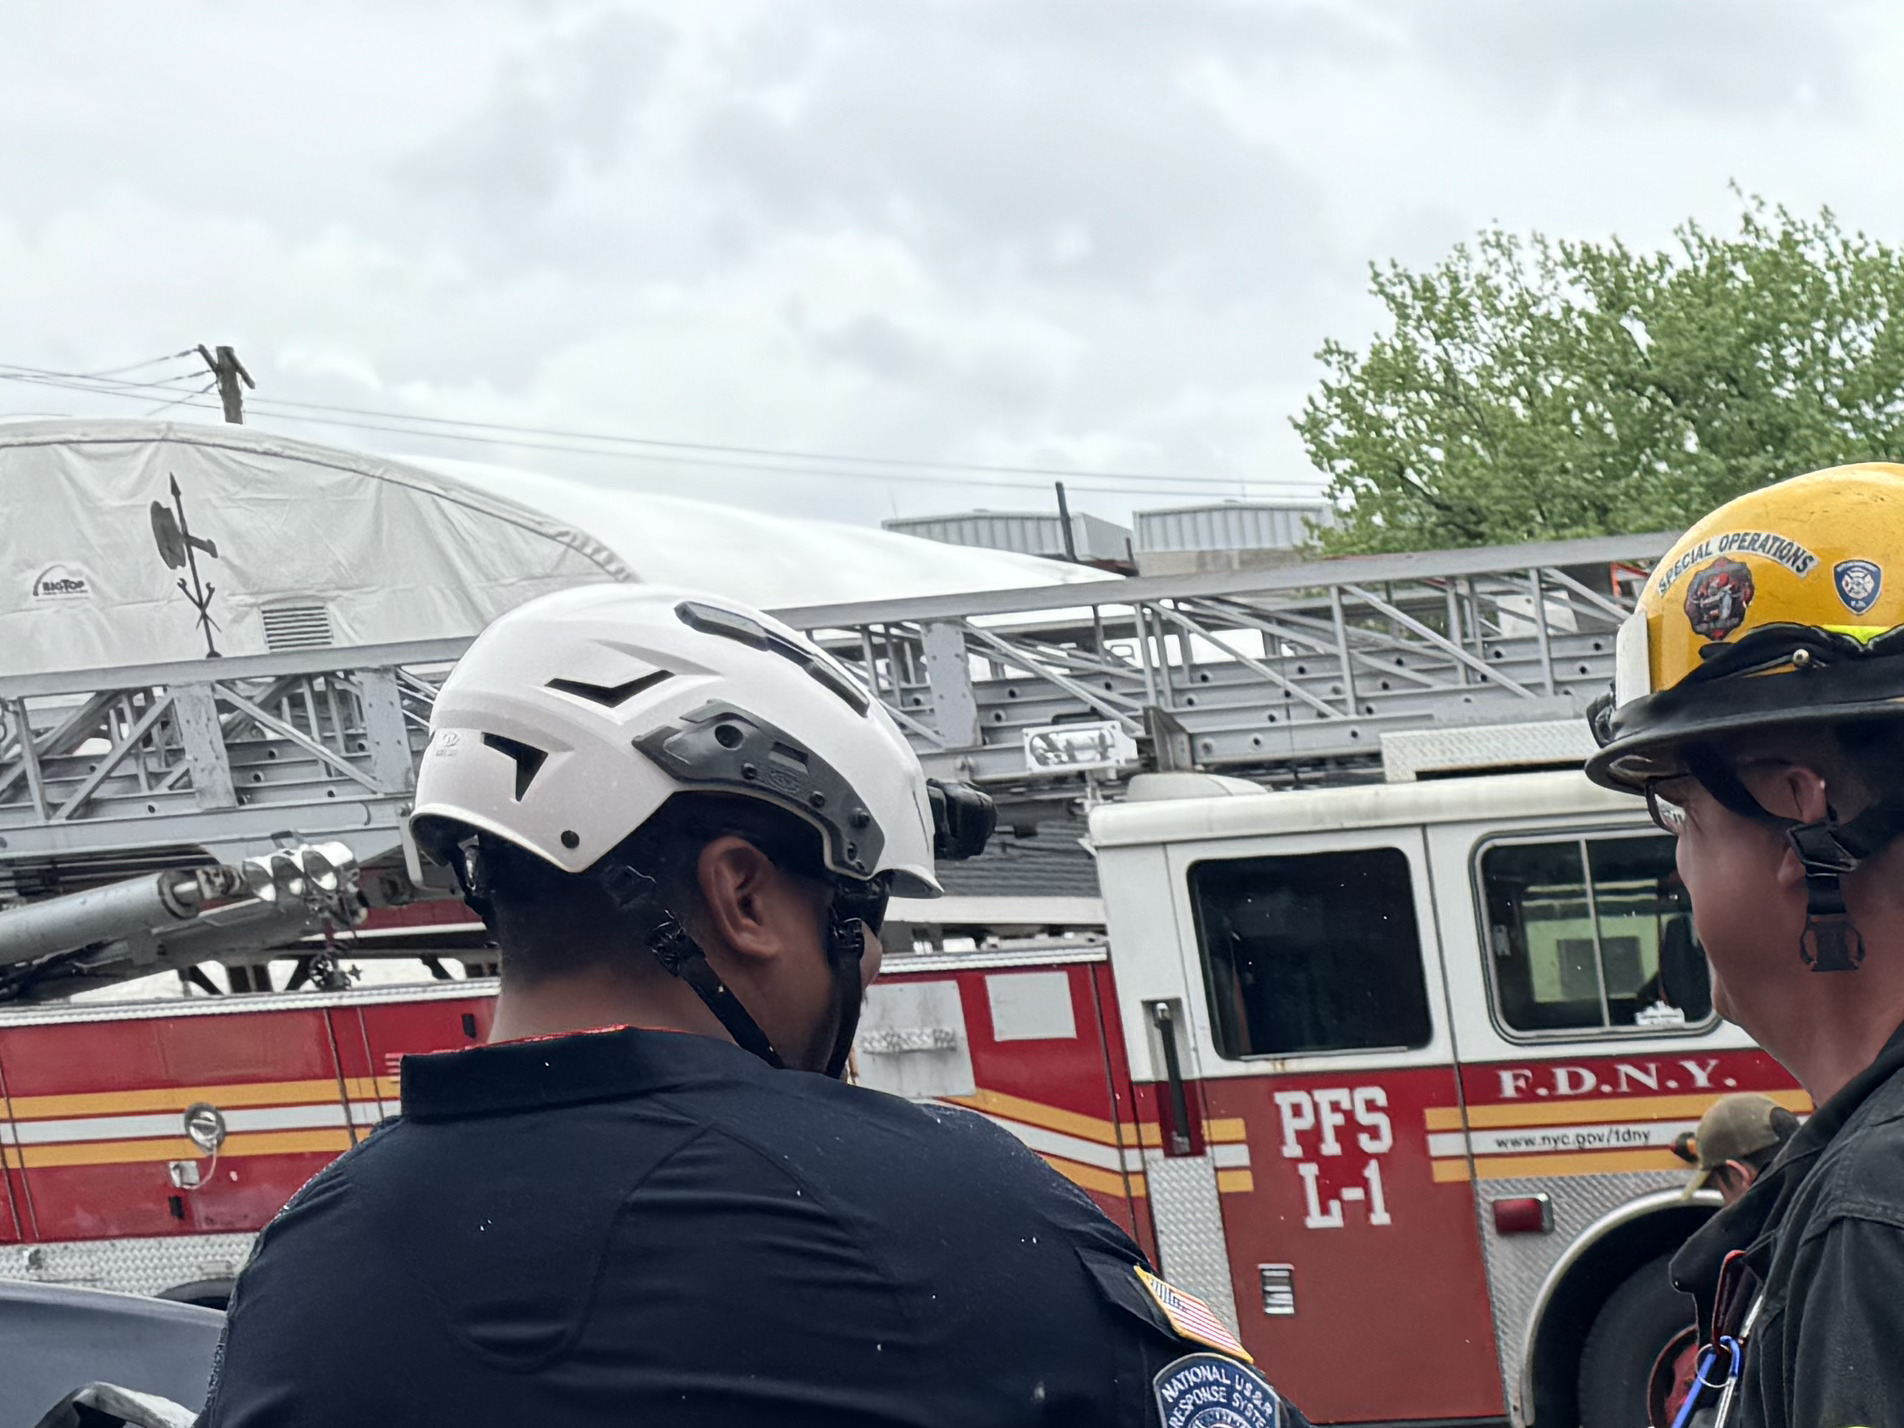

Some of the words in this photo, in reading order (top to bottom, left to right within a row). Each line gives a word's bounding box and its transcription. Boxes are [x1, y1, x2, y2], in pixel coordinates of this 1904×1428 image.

[1658, 541, 1713, 596] SPECIAL
[1718, 531, 1814, 574] OPERATIONS
[1499, 1059, 1738, 1099] F.D.N.Y.
[1274, 1086, 1394, 1159] PFS
[1298, 1158, 1392, 1230] L-1
[1161, 1365, 1231, 1403] NATIONAL
